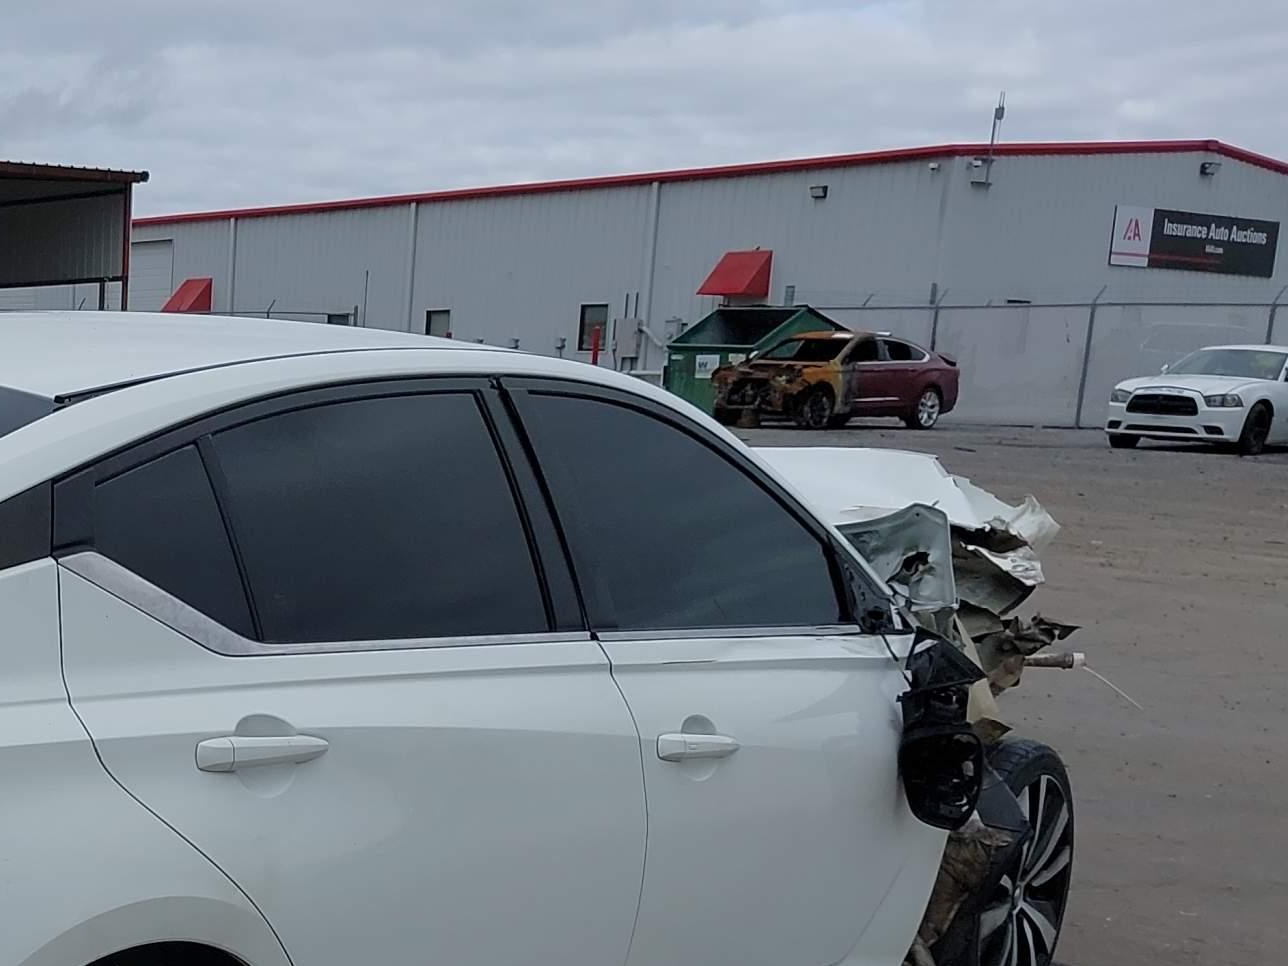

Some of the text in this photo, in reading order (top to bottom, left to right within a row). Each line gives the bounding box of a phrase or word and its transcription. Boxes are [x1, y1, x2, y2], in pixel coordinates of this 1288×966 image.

[1163, 218, 1267, 245] Insurance Auto Auctions
